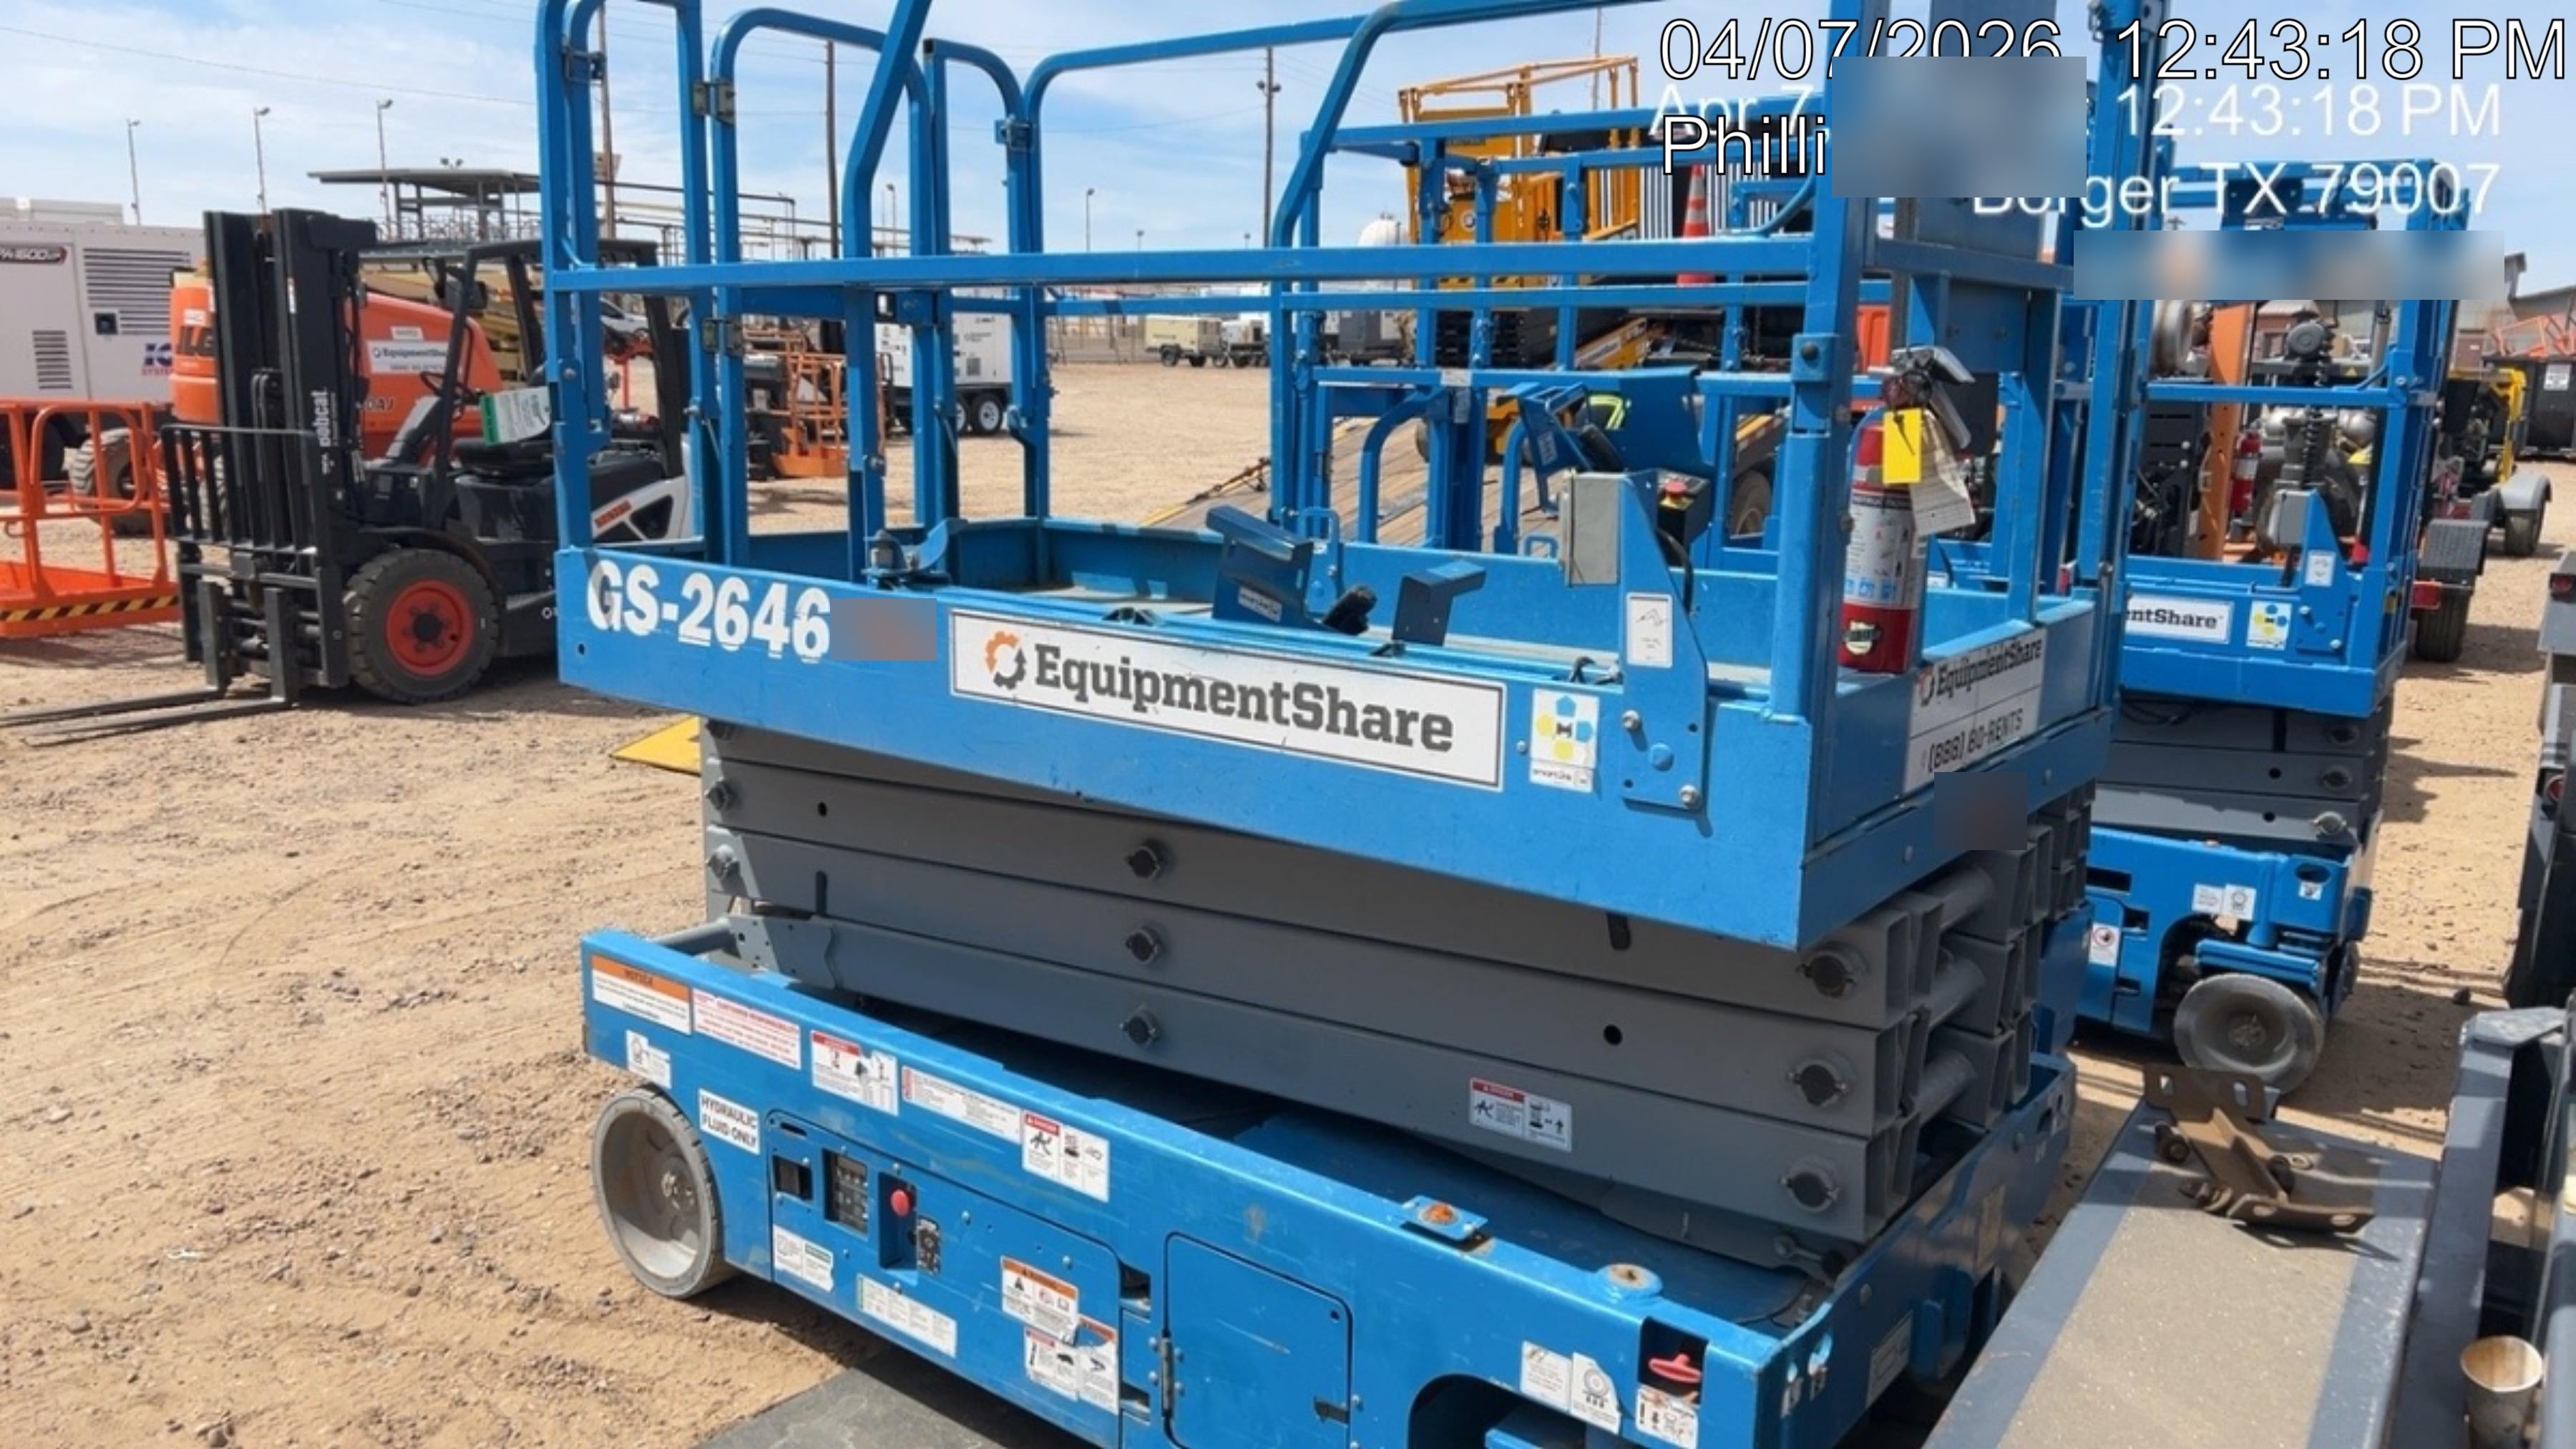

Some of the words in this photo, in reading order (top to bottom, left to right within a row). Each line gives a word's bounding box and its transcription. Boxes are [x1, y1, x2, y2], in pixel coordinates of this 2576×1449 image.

[587, 560, 831, 664] GS-2646
[1035, 643, 1453, 753] EquipmentShare
[1936, 638, 2042, 698] EquipmentShare
[702, 1096, 756, 1130] HYDRAULIC
[703, 1113, 729, 1136] FLUID
[731, 1126, 757, 1147] ONLY
